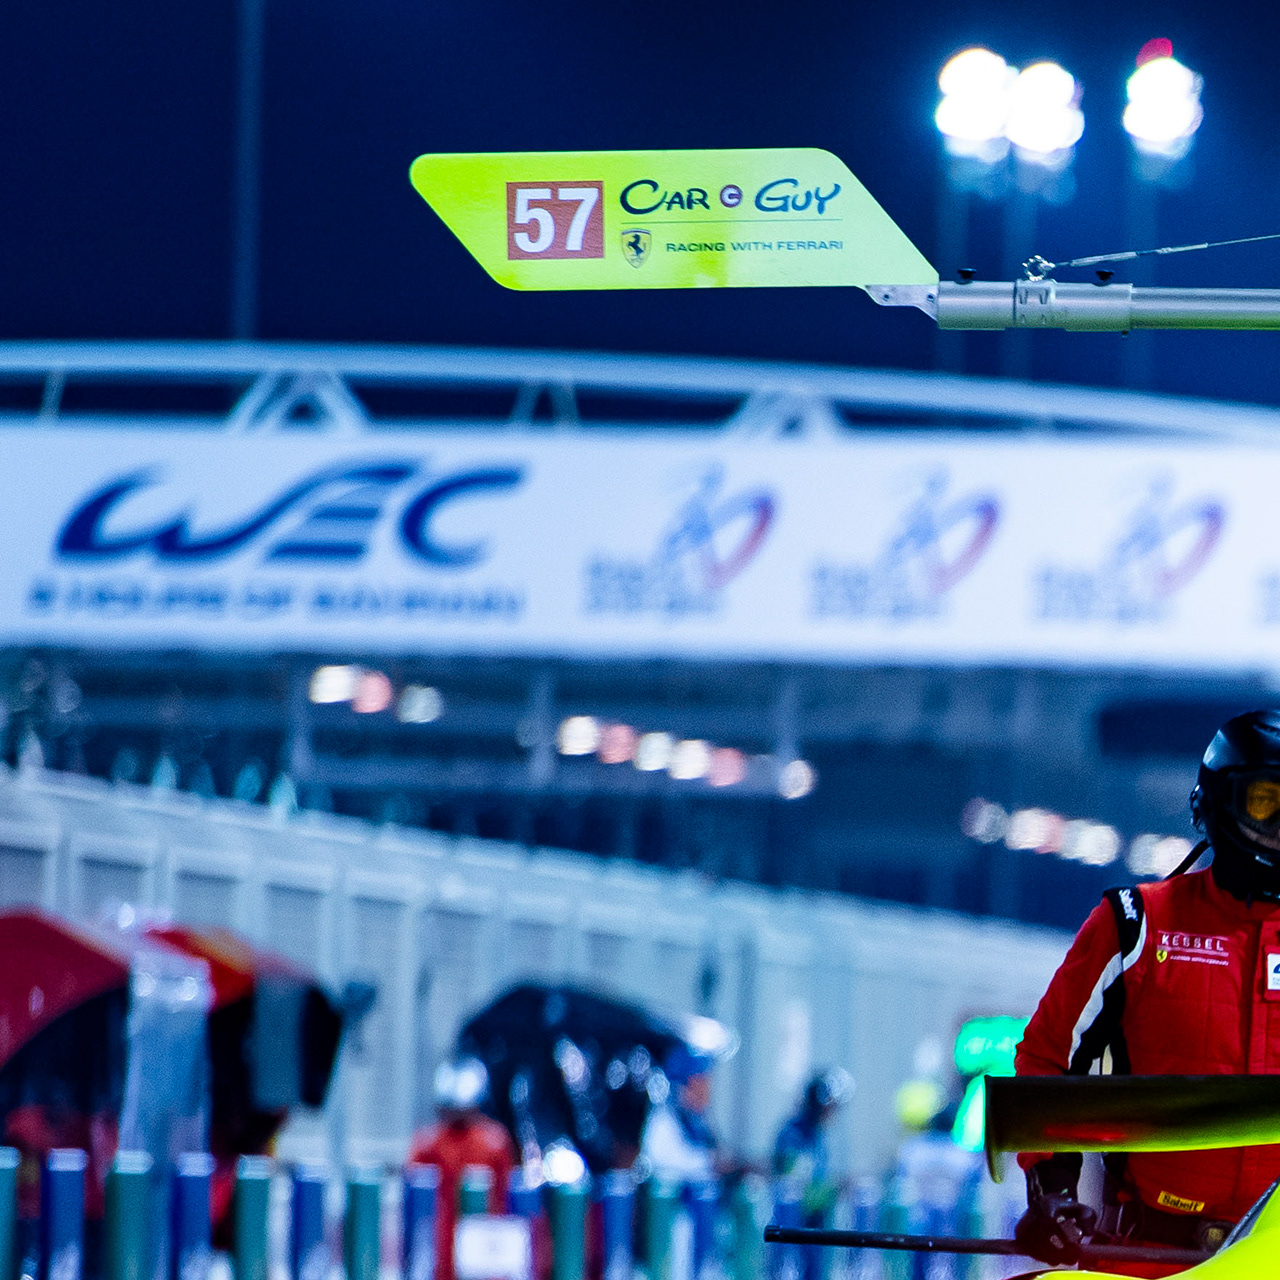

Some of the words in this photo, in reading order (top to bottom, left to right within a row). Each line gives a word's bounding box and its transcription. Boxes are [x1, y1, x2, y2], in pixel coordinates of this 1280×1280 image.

[619, 179, 710, 215] CAR
[754, 178, 841, 214] GUY
[514, 187, 600, 253] 57
[666, 241, 726, 253] RACING
[730, 240, 774, 252] WITH
[777, 240, 843, 252] FERRARI
[54, 455, 528, 570] WEC
[1161, 933, 1225, 952] KESSEL
